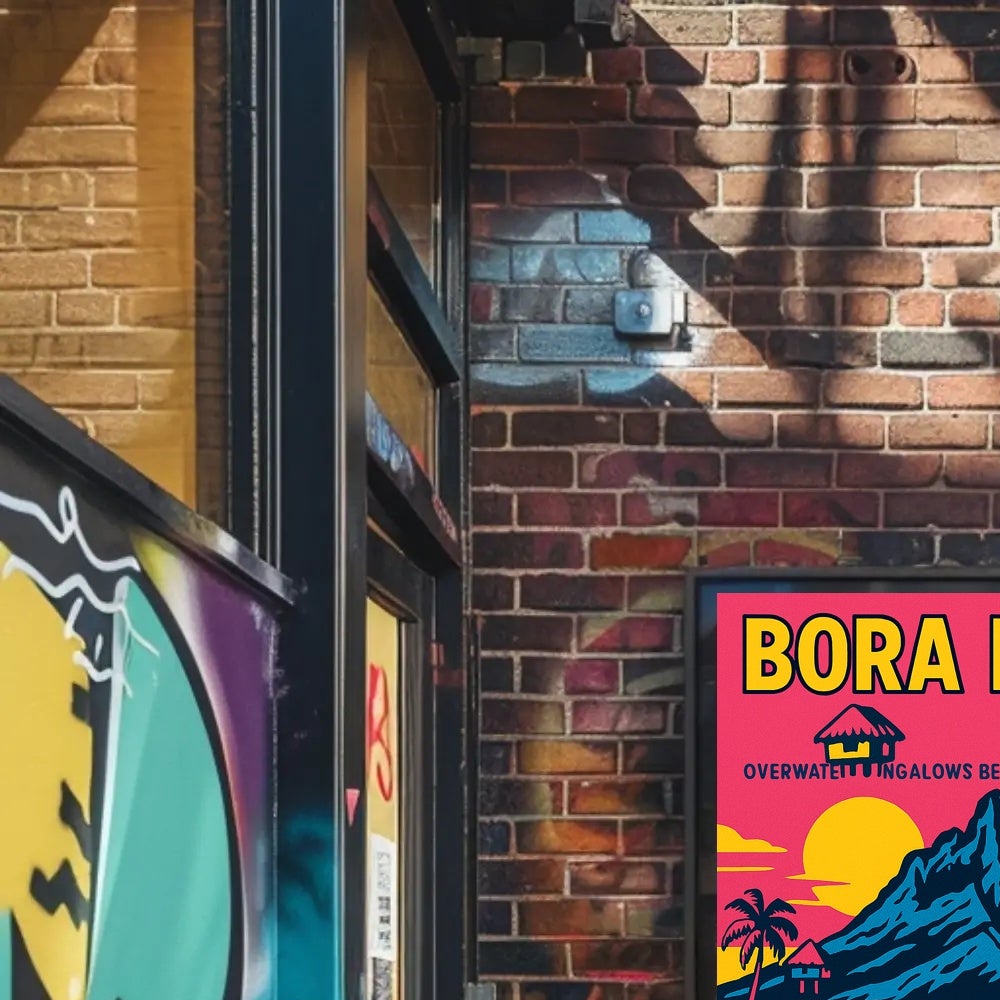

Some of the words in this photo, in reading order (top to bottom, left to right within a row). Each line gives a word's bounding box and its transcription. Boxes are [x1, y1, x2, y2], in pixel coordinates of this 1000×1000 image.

[742, 612, 965, 696] BORA
[743, 763, 850, 780] OVERWATE
[861, 763, 973, 780] NGALOWS
